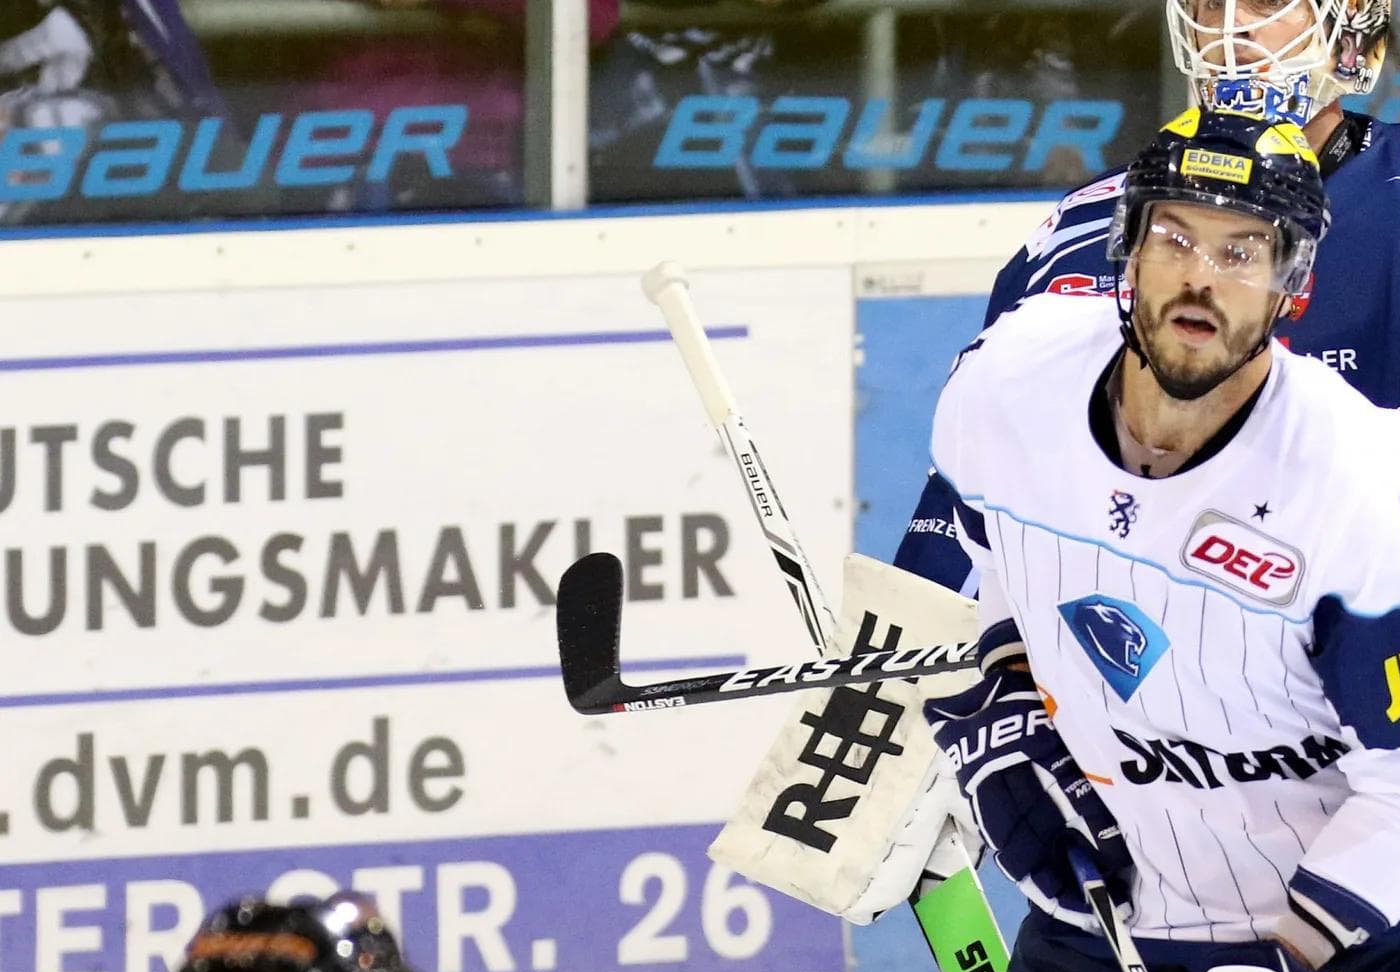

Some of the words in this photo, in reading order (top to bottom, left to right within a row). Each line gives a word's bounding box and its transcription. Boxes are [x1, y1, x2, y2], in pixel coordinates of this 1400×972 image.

[1187, 151, 1247, 172] EDEKA
[1190, 534, 1297, 591] DEL
[719, 640, 978, 694] EASTON
[623, 695, 686, 713] EASTON
[618, 851, 773, 967] 26
